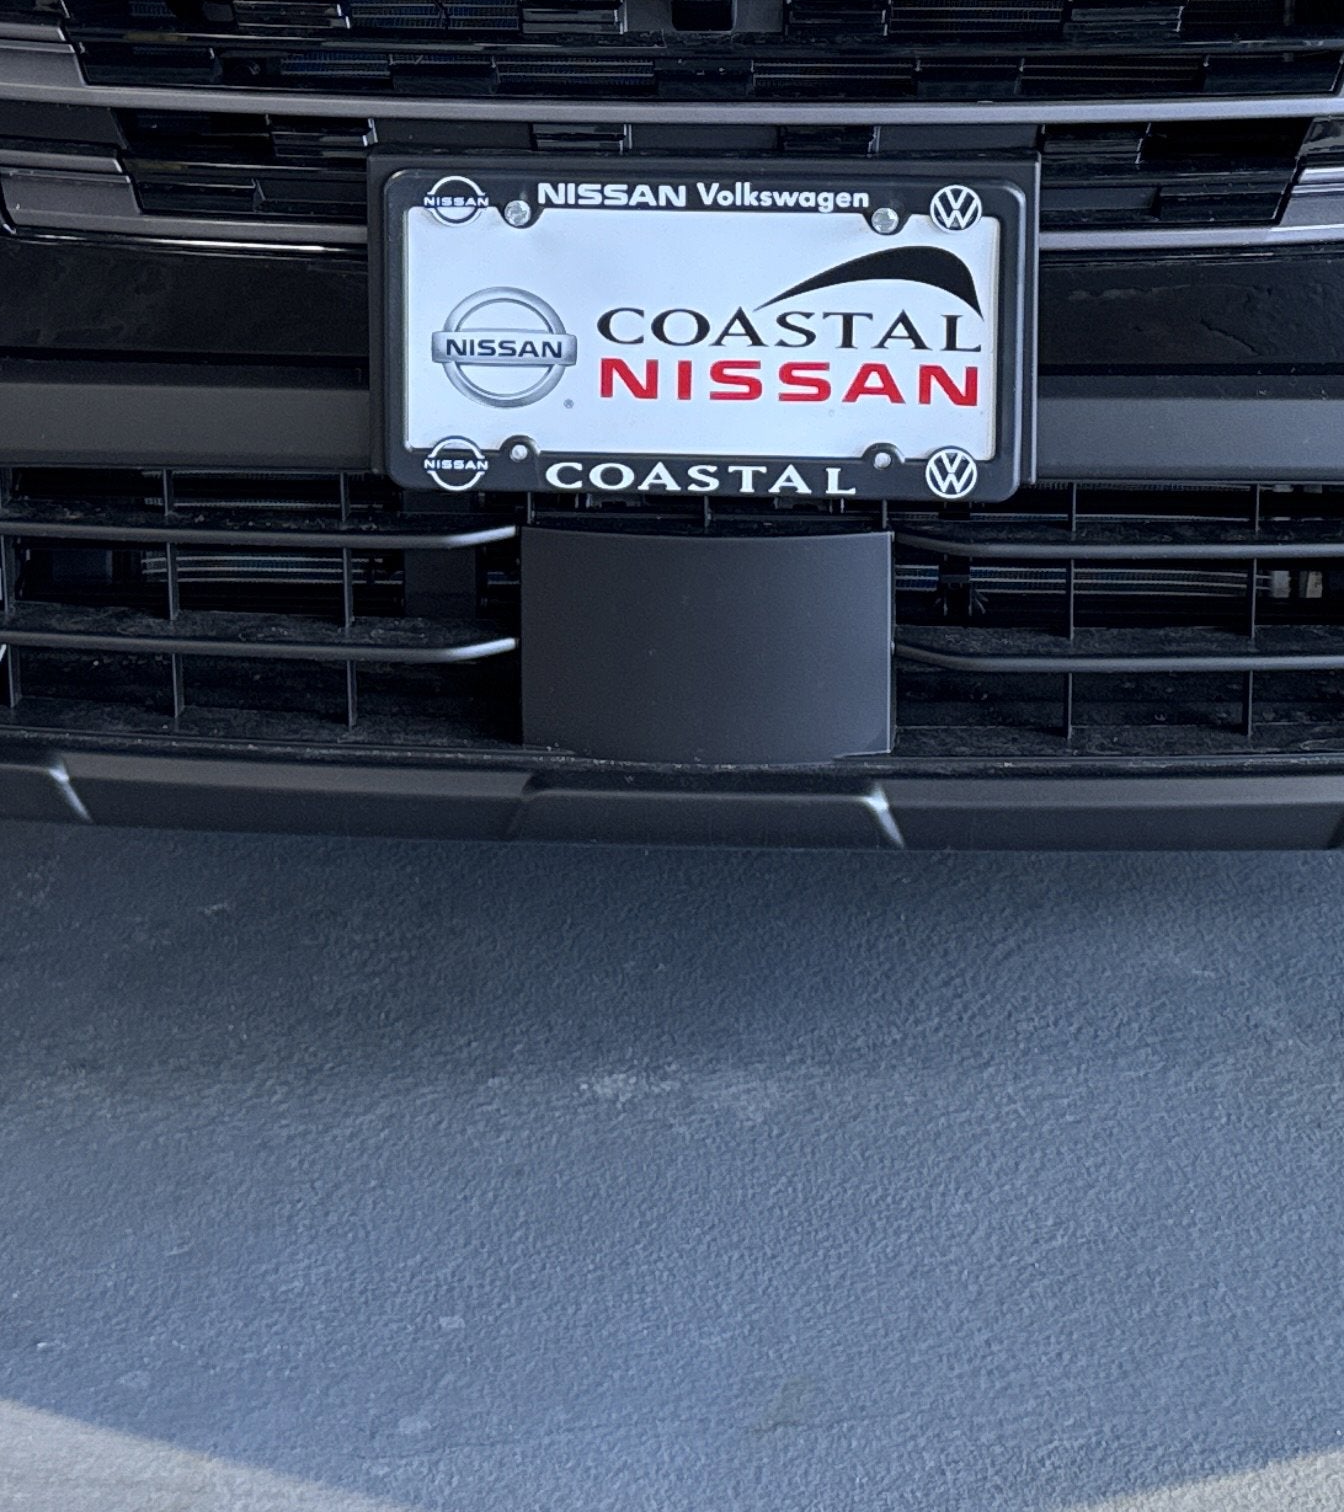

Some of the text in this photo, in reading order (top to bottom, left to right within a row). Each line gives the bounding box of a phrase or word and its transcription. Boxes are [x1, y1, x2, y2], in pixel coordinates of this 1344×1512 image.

[423, 196, 489, 207] NISSAN
[537, 182, 870, 213] NISSAN Volkswagen
[596, 306, 983, 353] COASTAL
[446, 339, 562, 359] NISSAN
[600, 357, 978, 406] NISSAN
[423, 459, 489, 471] NISSAN
[545, 461, 857, 496] COASTAL
